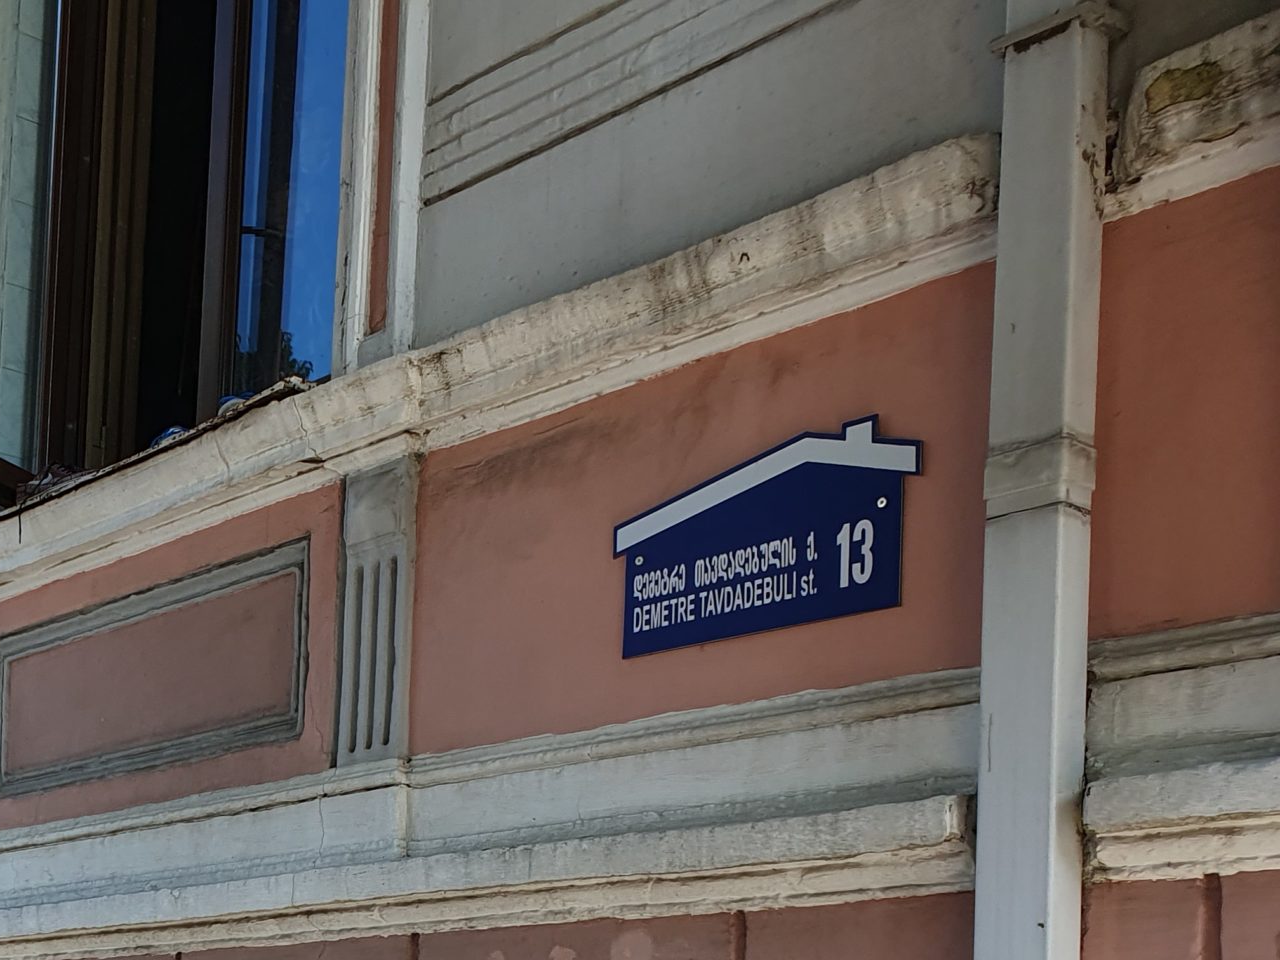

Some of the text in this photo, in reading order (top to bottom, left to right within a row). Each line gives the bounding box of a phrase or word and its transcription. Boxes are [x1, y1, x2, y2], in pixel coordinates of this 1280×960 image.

[633, 531, 818, 601] დემეტრე თავდადებულის ქ.
[836, 519, 874, 588] 13
[633, 568, 817, 633] DEMETRE TAVDADEBULI st.
